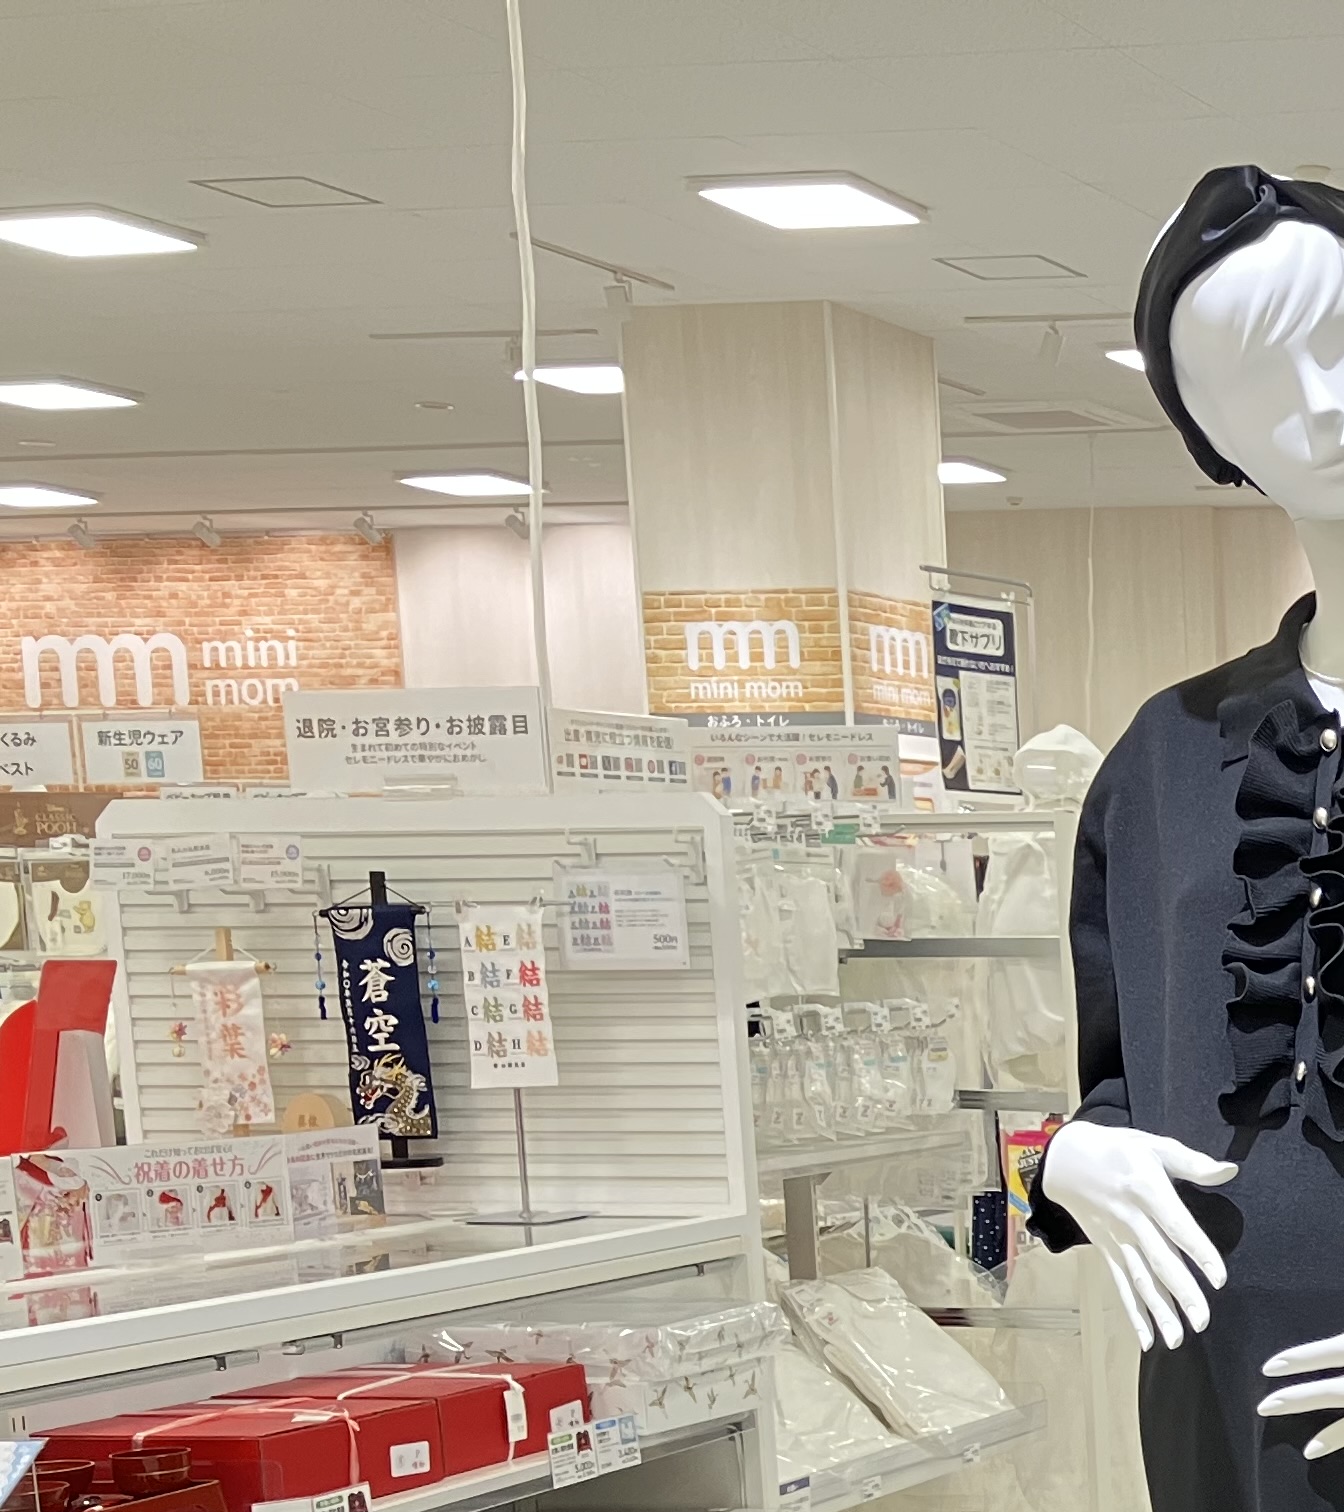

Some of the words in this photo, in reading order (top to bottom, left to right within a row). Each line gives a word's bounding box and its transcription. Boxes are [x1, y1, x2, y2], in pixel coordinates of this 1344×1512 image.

[202, 629, 298, 667] mini
[690, 677, 739, 700] mini
[745, 679, 803, 699] mom
[296, 714, 529, 739] 退院・お宮参り・お披露目
[97, 729, 184, 747] 新生児ウェア
[124, 758, 139, 770] 50
[148, 758, 162, 770] 60
[35, 821, 77, 833] POOH
[464, 936, 472, 947] A
[503, 935, 510, 946] E
[468, 971, 475, 982] B
[506, 969, 513, 980] F
[359, 958, 399, 1052] 蒼空
[471, 1006, 479, 1016] C
[509, 1003, 518, 1014] G
[474, 1040, 482, 1051] D
[512, 1039, 521, 1050] H
[134, 1155, 245, 1184] 祝着の着せ方
